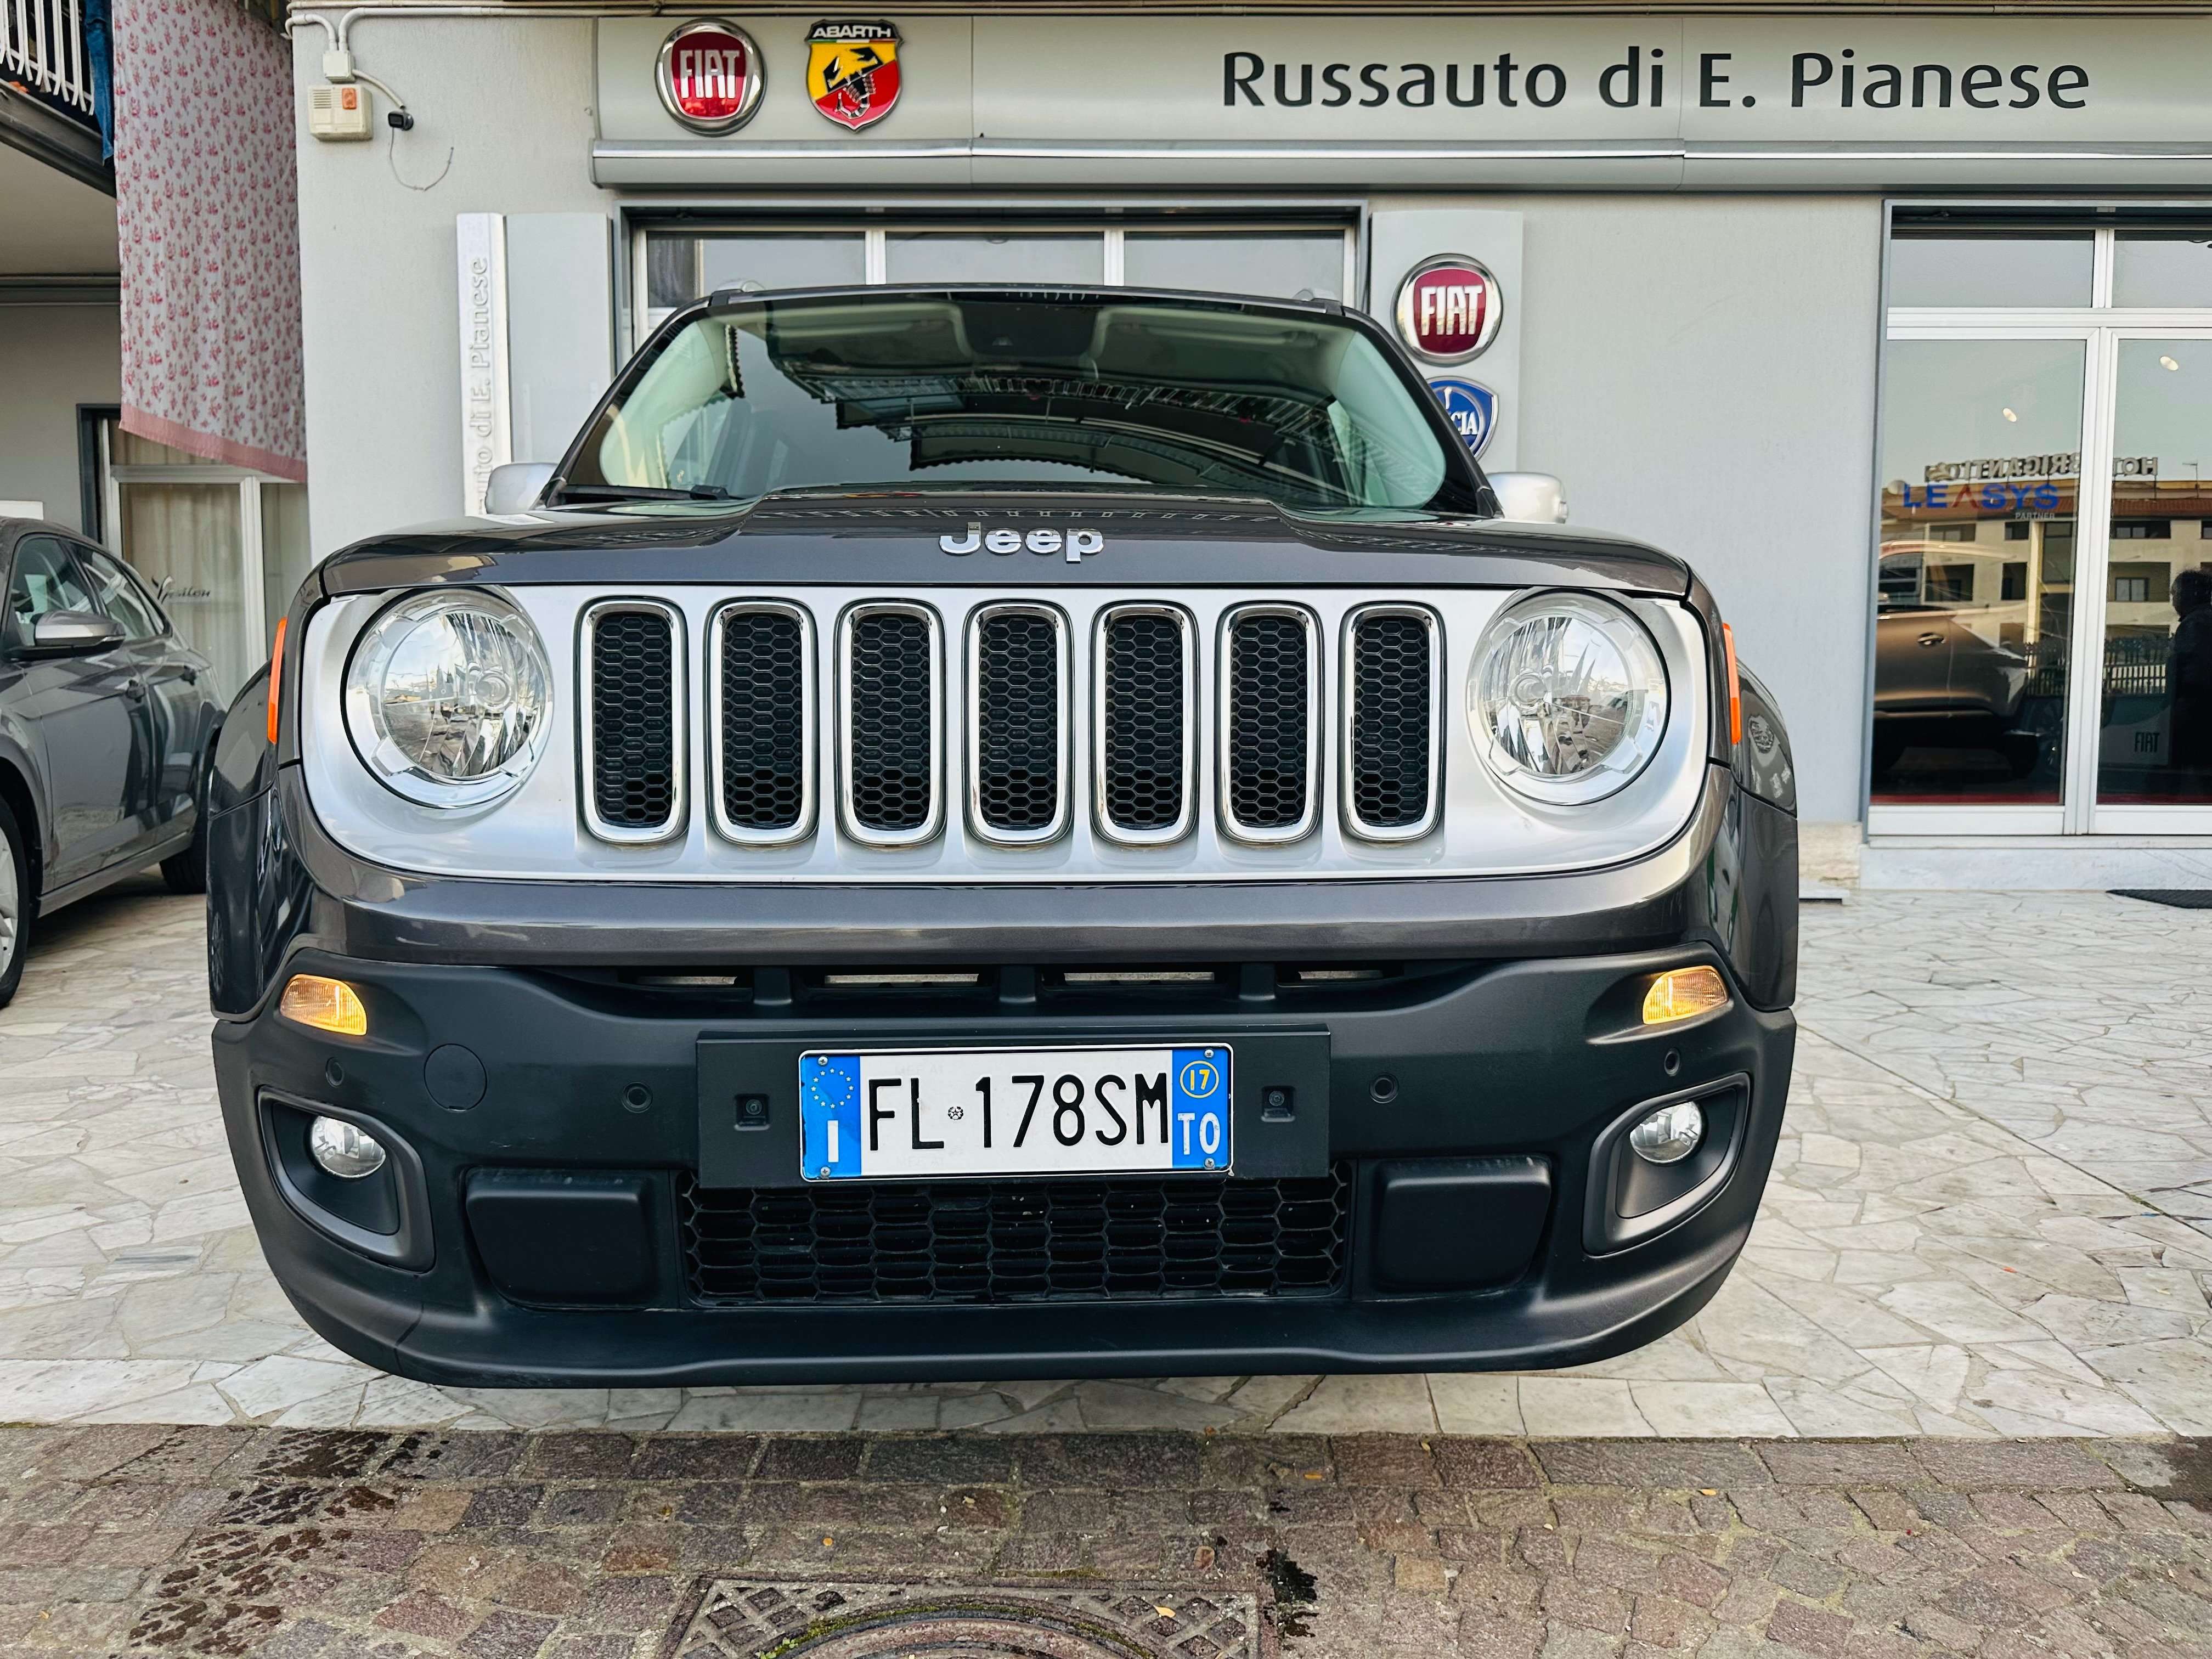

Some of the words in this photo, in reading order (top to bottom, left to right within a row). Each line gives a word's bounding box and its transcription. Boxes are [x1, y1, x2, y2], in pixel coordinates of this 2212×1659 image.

[812, 25, 891, 38] ABARTH
[679, 49, 740, 99] FIAT
[1223, 52, 1567, 108] Russauto
[1598, 46, 1664, 108] di
[1699, 53, 1756, 108] E.
[1791, 48, 2090, 109] Pianese
[469, 257, 490, 368] Pianese
[1420, 285, 1483, 336] FIAT
[471, 377, 492, 403] E.
[470, 411, 492, 439] di
[1449, 410, 1479, 435] CIA
[1902, 482, 2059, 510] LEASYS
[939, 522, 1104, 564] Jeep
[2134, 731, 2160, 753] FIAT
[1190, 1069, 1210, 1091] 17
[1177, 1111, 1221, 1156] TO
